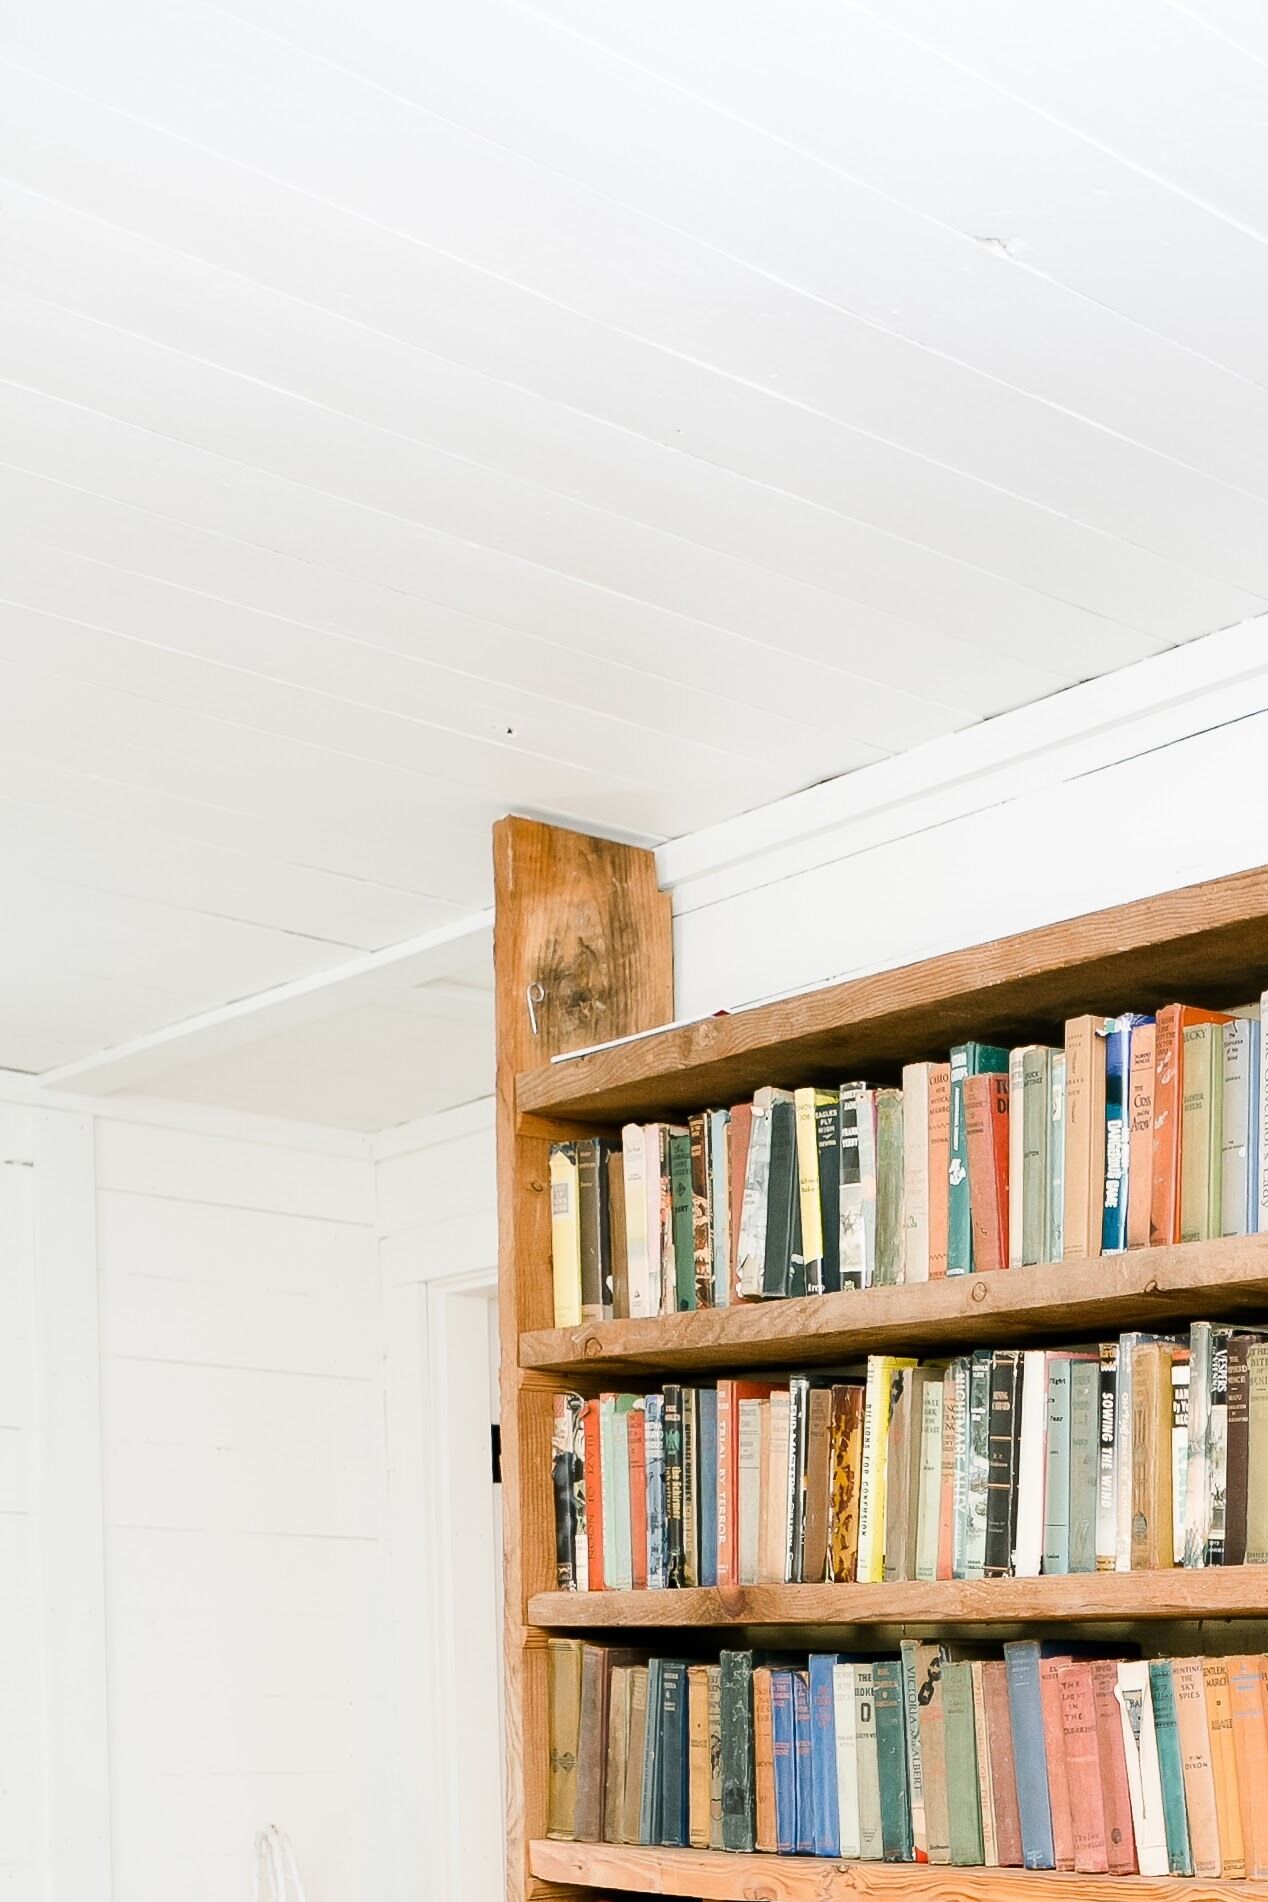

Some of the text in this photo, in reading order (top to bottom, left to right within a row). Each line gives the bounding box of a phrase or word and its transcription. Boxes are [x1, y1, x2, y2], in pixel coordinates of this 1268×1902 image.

[1250, 1347, 1268, 1356] THE
[1101, 1392, 1114, 1508] SOWING THE WIND
[858, 1673, 872, 1682] THE
[1062, 1681, 1080, 1689] THE
[1181, 1684, 1195, 1692] SKY
[1179, 1692, 1201, 1700] SPIES
[1065, 1714, 1083, 1722] THE
[907, 1666, 921, 1791] VICTORIA ALBERT
[1185, 1762, 1208, 1771] DIXON
